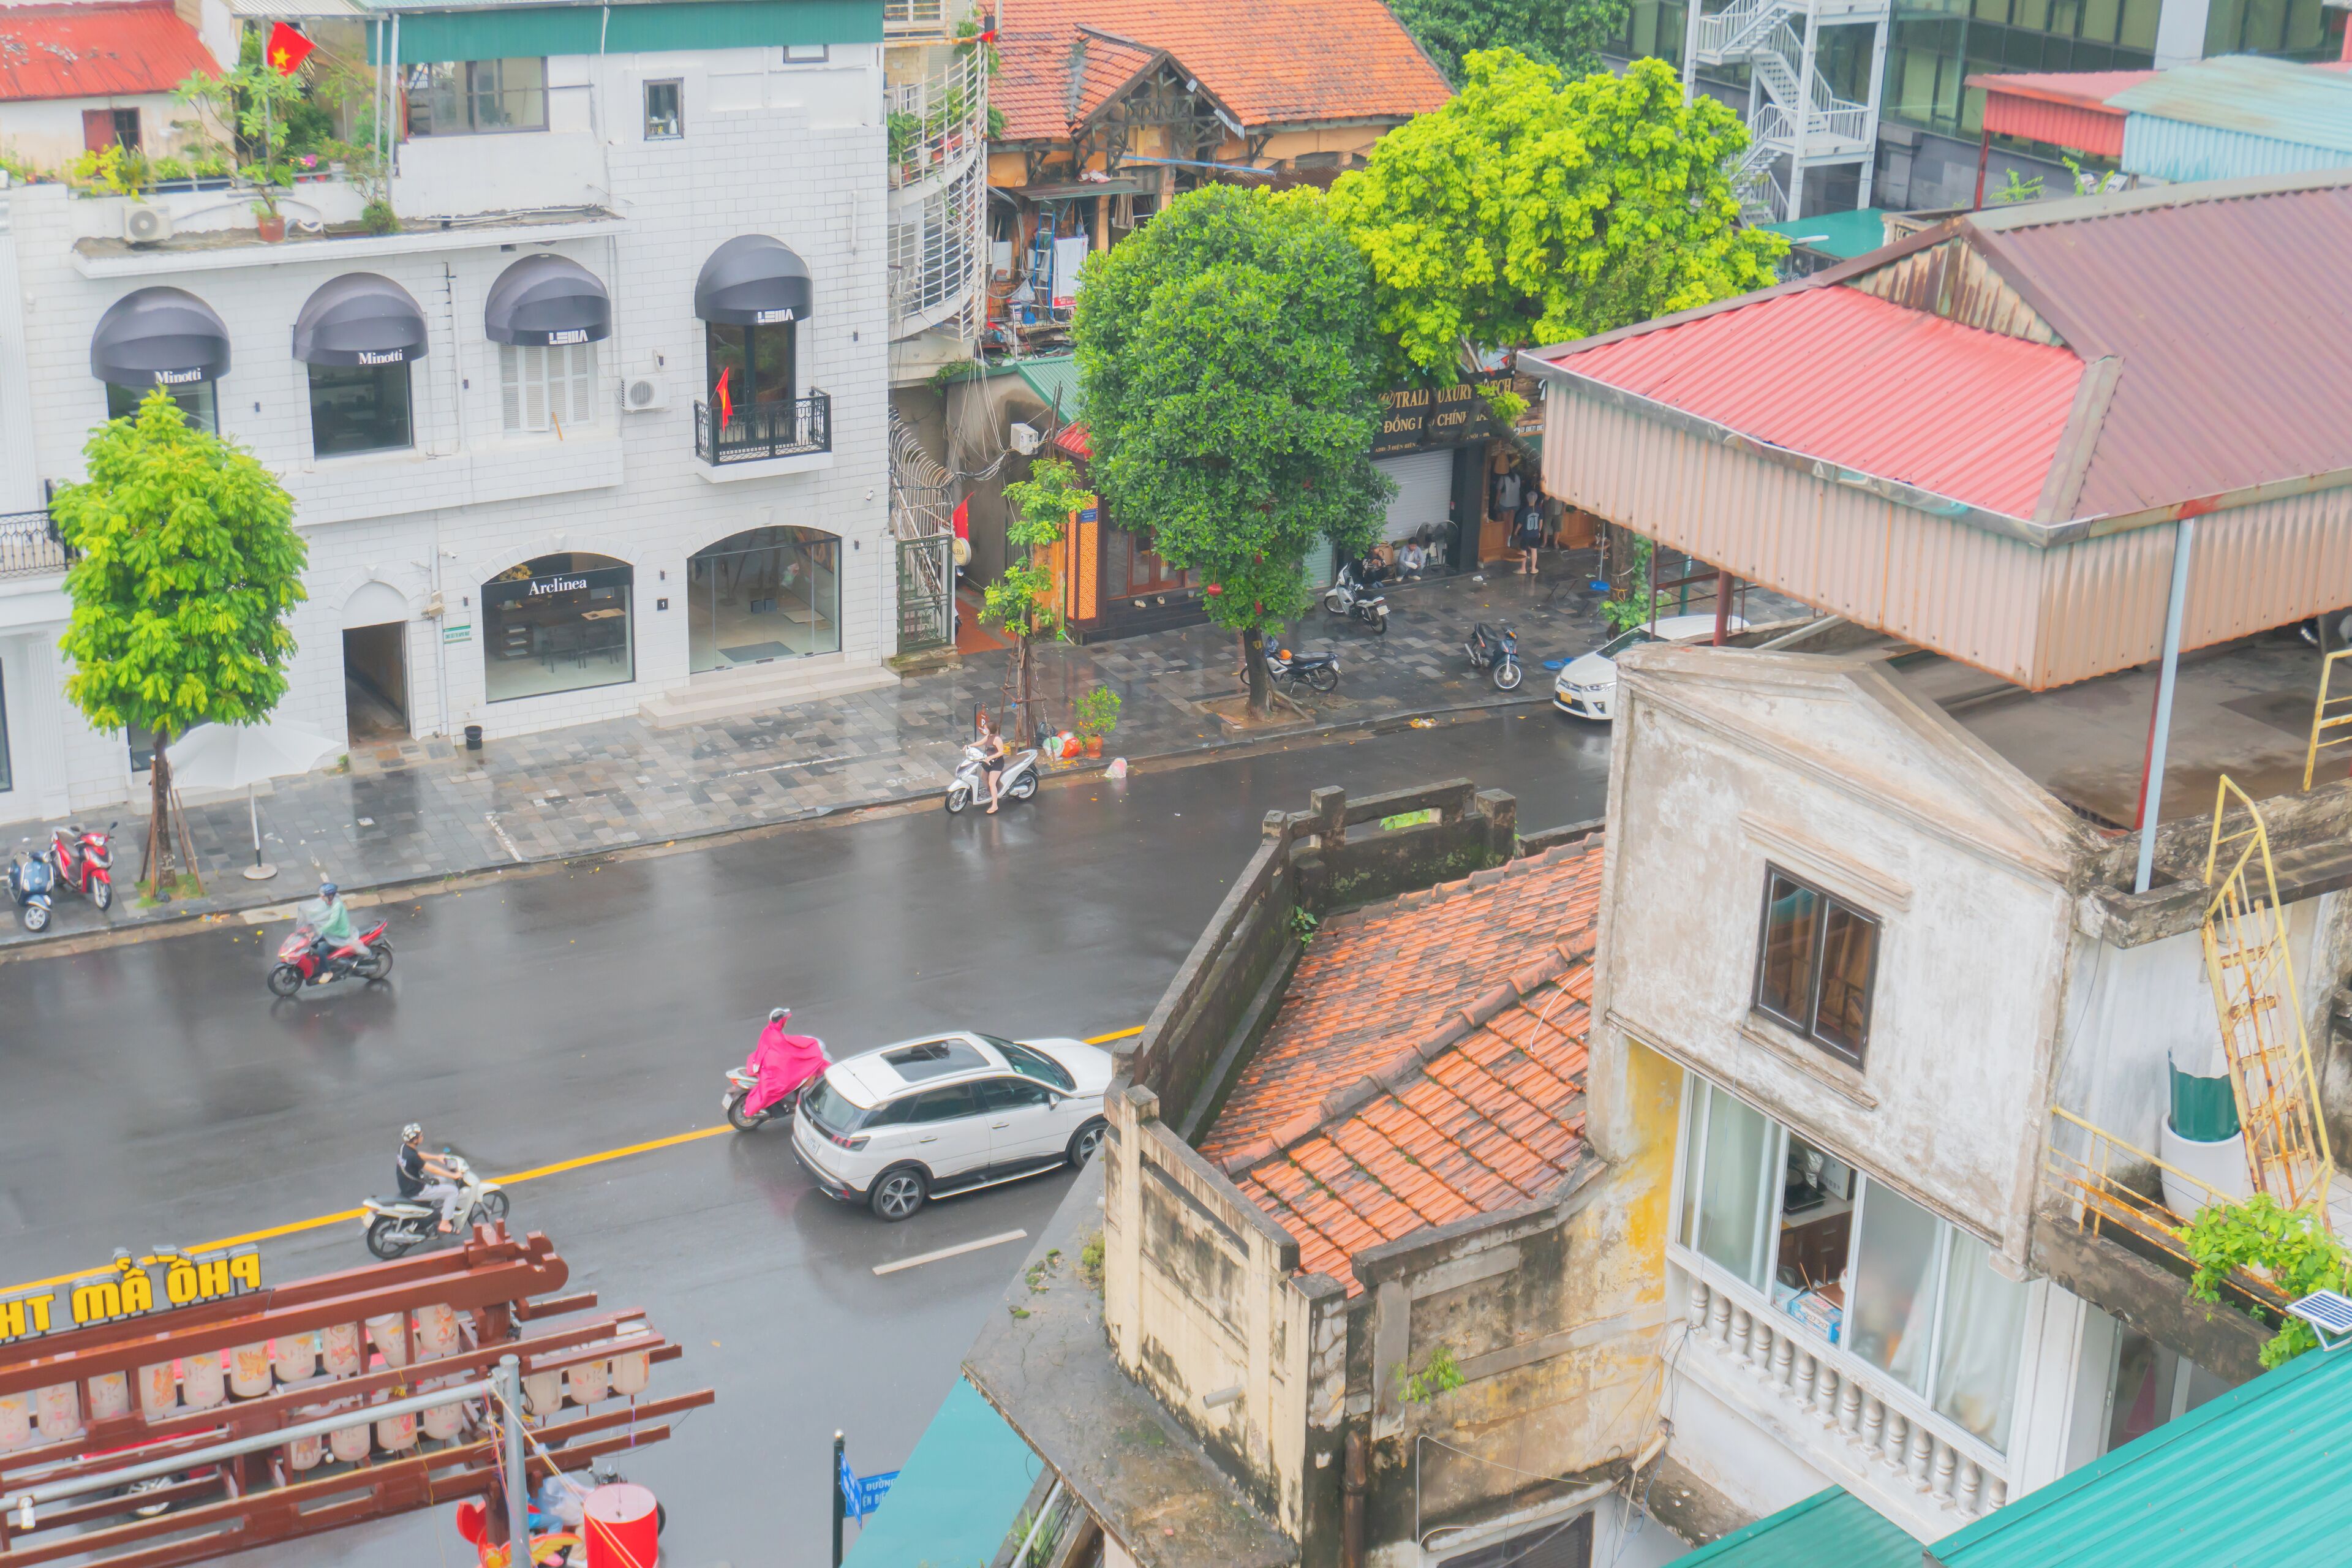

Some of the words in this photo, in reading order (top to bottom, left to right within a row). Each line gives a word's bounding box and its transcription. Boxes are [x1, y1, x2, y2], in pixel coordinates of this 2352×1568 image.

[359, 349, 402, 365] Minotti
[155, 368, 202, 384] Minotti
[1436, 383, 1472, 404] UXURY
[1478, 377, 1512, 397] ATCH
[529, 577, 587, 596] Arclinea
[875, 1491, 886, 1505] BIÊ
